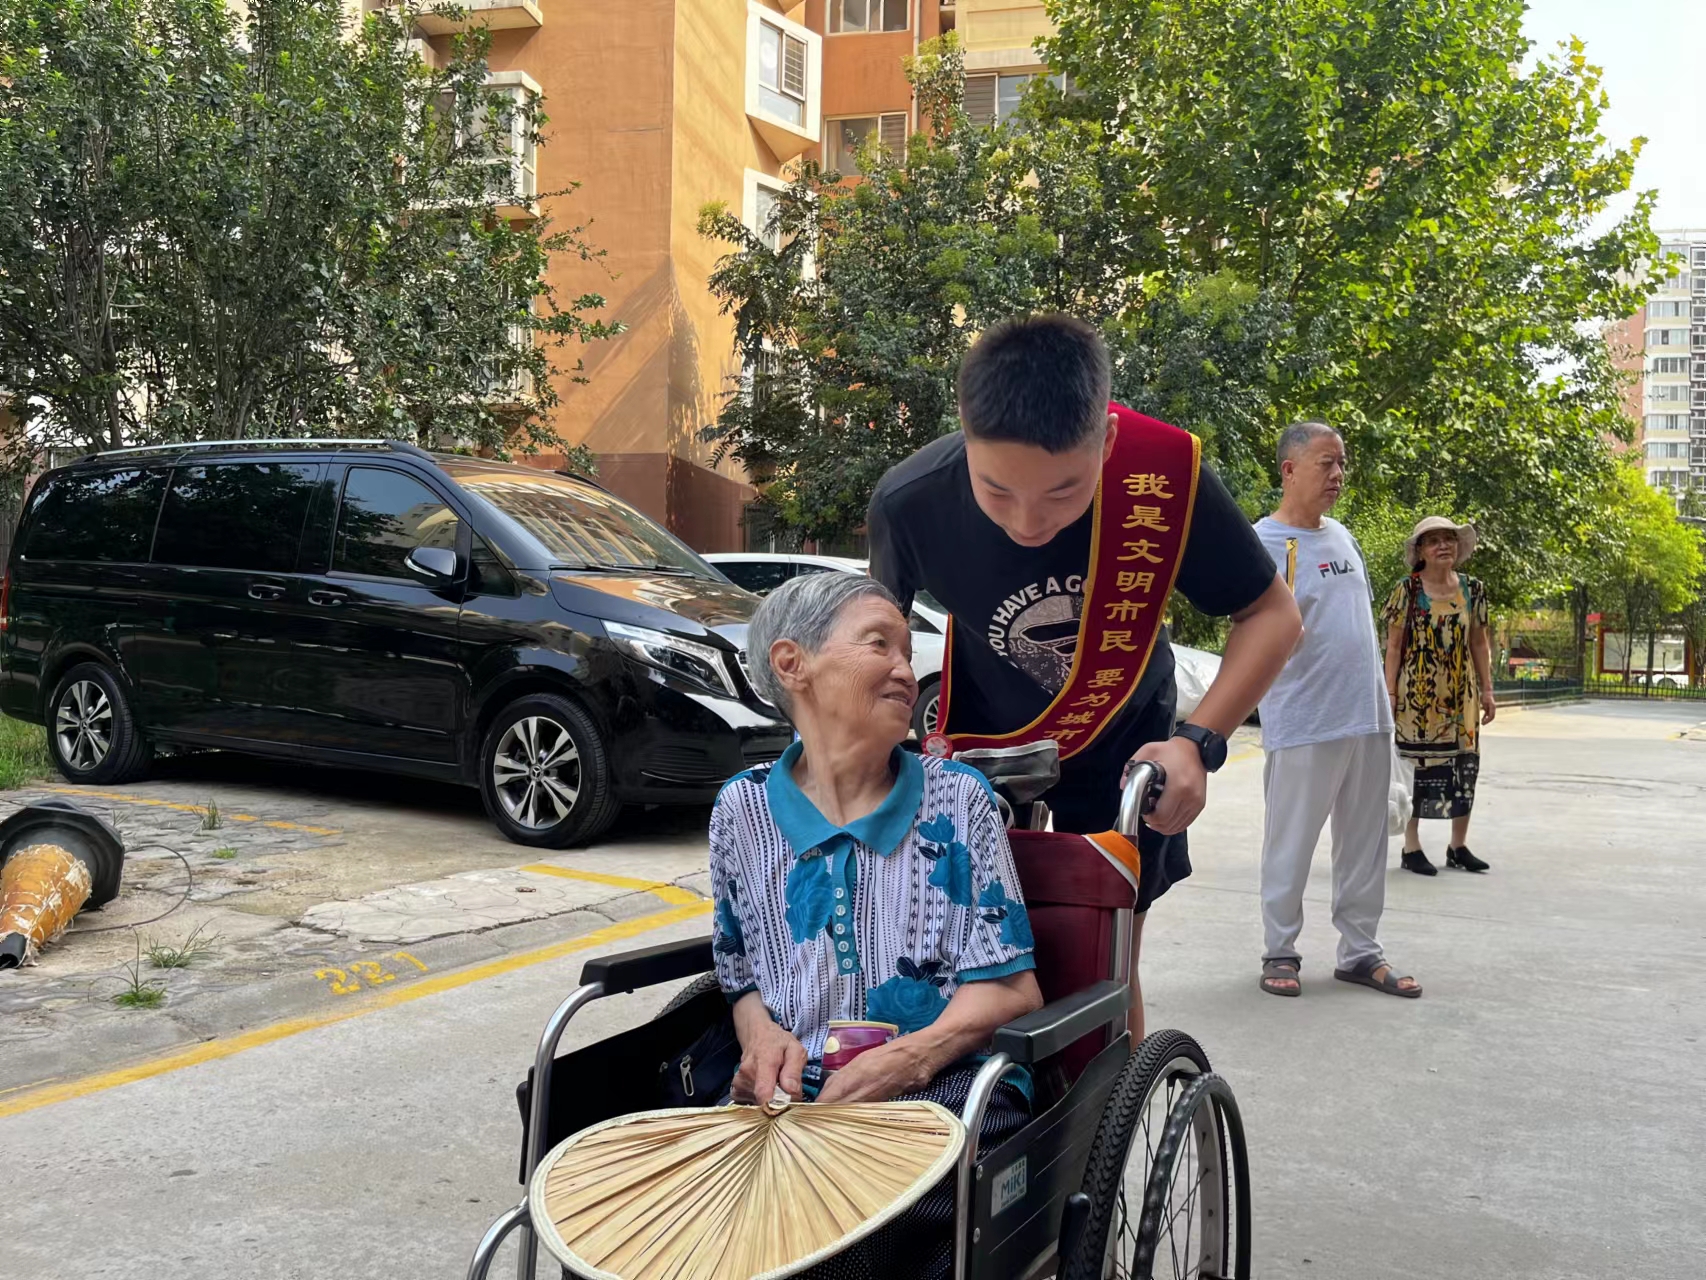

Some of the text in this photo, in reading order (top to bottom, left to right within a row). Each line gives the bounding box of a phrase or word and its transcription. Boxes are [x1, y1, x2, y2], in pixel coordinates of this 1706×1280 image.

[1317, 560, 1356, 579] FILA
[991, 583, 1043, 626] HAVE
[1045, 576, 1062, 594] A
[1042, 473, 1175, 749] 我是文明市民 要为城市
